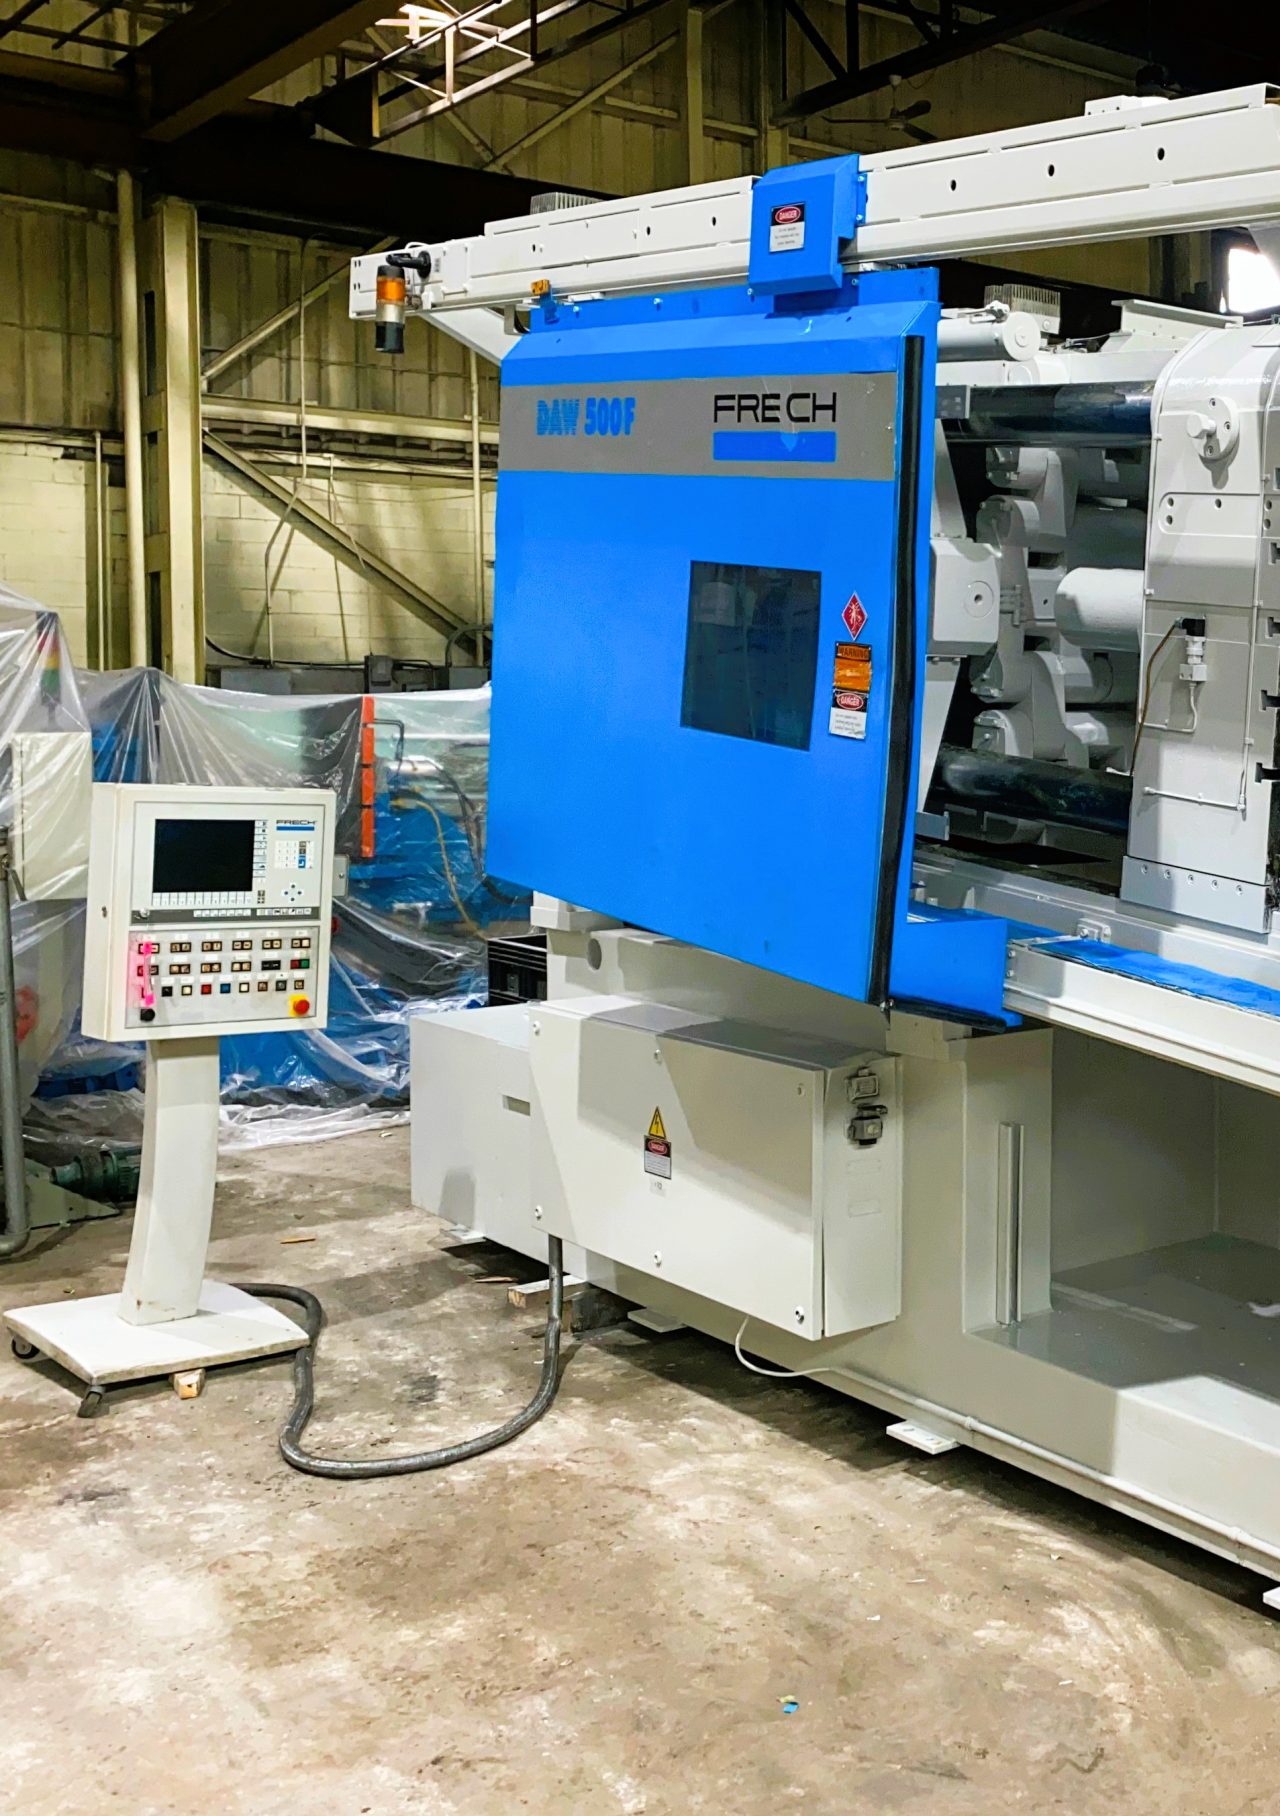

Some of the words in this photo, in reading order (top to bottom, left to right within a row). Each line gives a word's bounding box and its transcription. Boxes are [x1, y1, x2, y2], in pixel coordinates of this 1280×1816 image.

[536, 399, 579, 437] DAW
[584, 397, 636, 437] 500F
[713, 392, 838, 424] FRECH
[838, 646, 869, 660] WARNING
